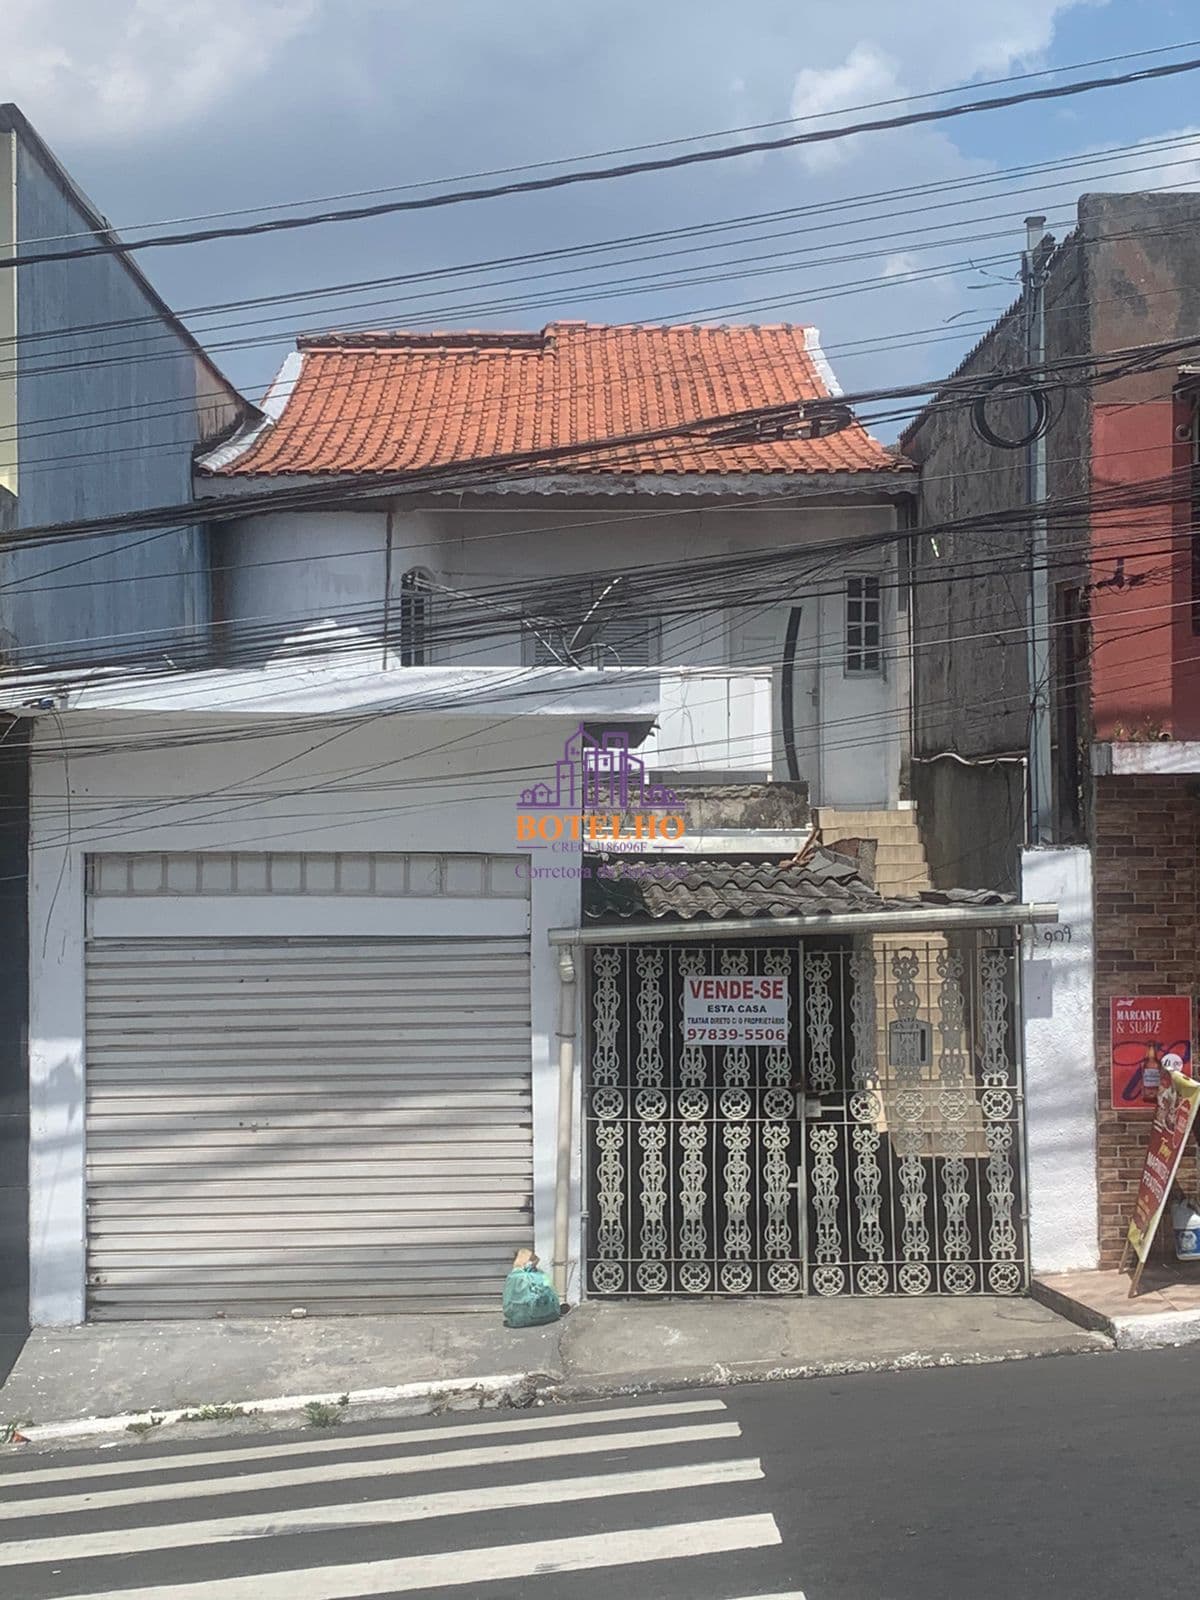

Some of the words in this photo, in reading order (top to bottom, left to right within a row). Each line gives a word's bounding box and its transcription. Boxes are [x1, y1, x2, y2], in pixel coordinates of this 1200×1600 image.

[690, 980, 784, 999] VENDE-SE
[707, 1005, 735, 1013] ESTA
[738, 1005, 767, 1013] CASA
[687, 1017, 709, 1025] TRATAR
[710, 1017, 730, 1025] DIRETO
[1116, 1010, 1162, 1021] MARCANTE
[1129, 1021, 1162, 1034] SUAVE
[687, 1028, 785, 1040] 97839-5506
